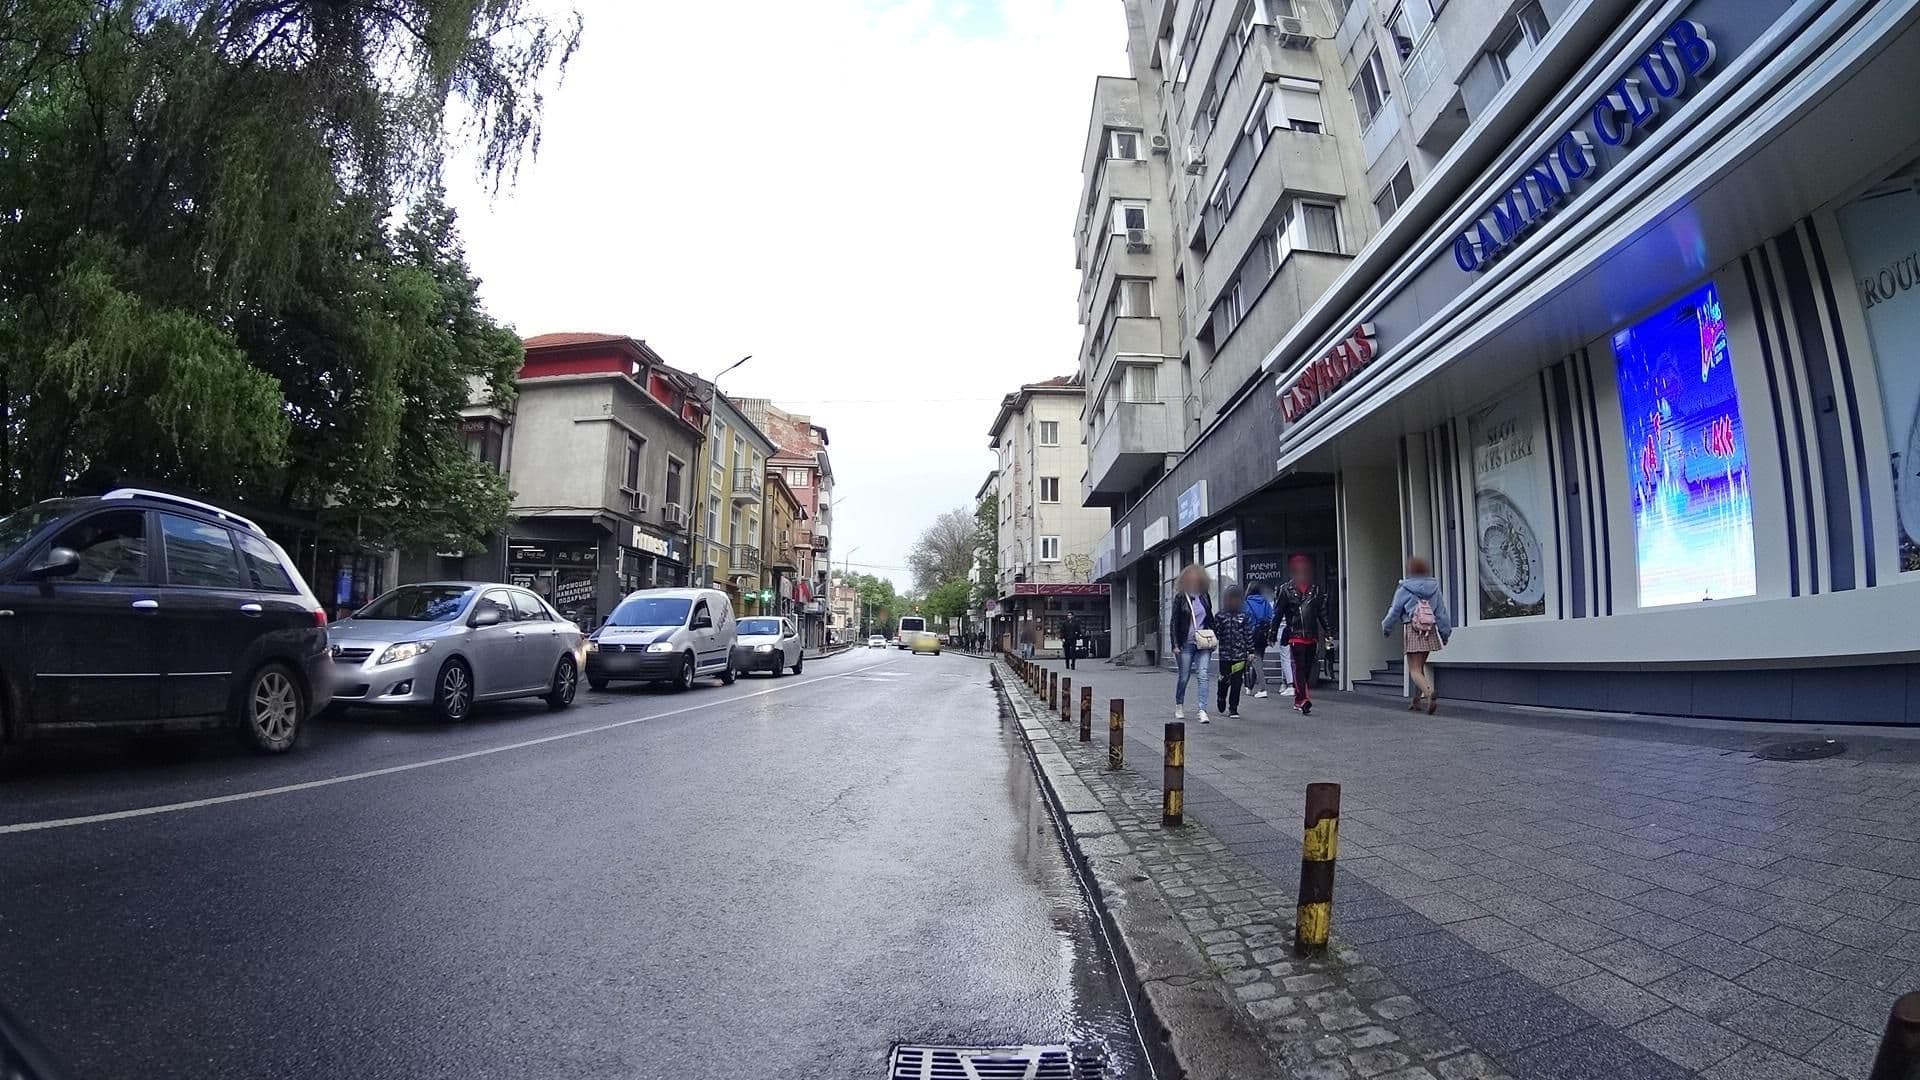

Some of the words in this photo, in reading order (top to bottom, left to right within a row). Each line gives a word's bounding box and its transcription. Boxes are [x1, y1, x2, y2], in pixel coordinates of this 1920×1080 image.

[1454, 130, 1597, 273] GAMING
[1591, 20, 1717, 146] CLUB
[1246, 570, 1281, 581] ПРОДУКТИ
[558, 579, 591, 591] ПРОМОЦИИ
